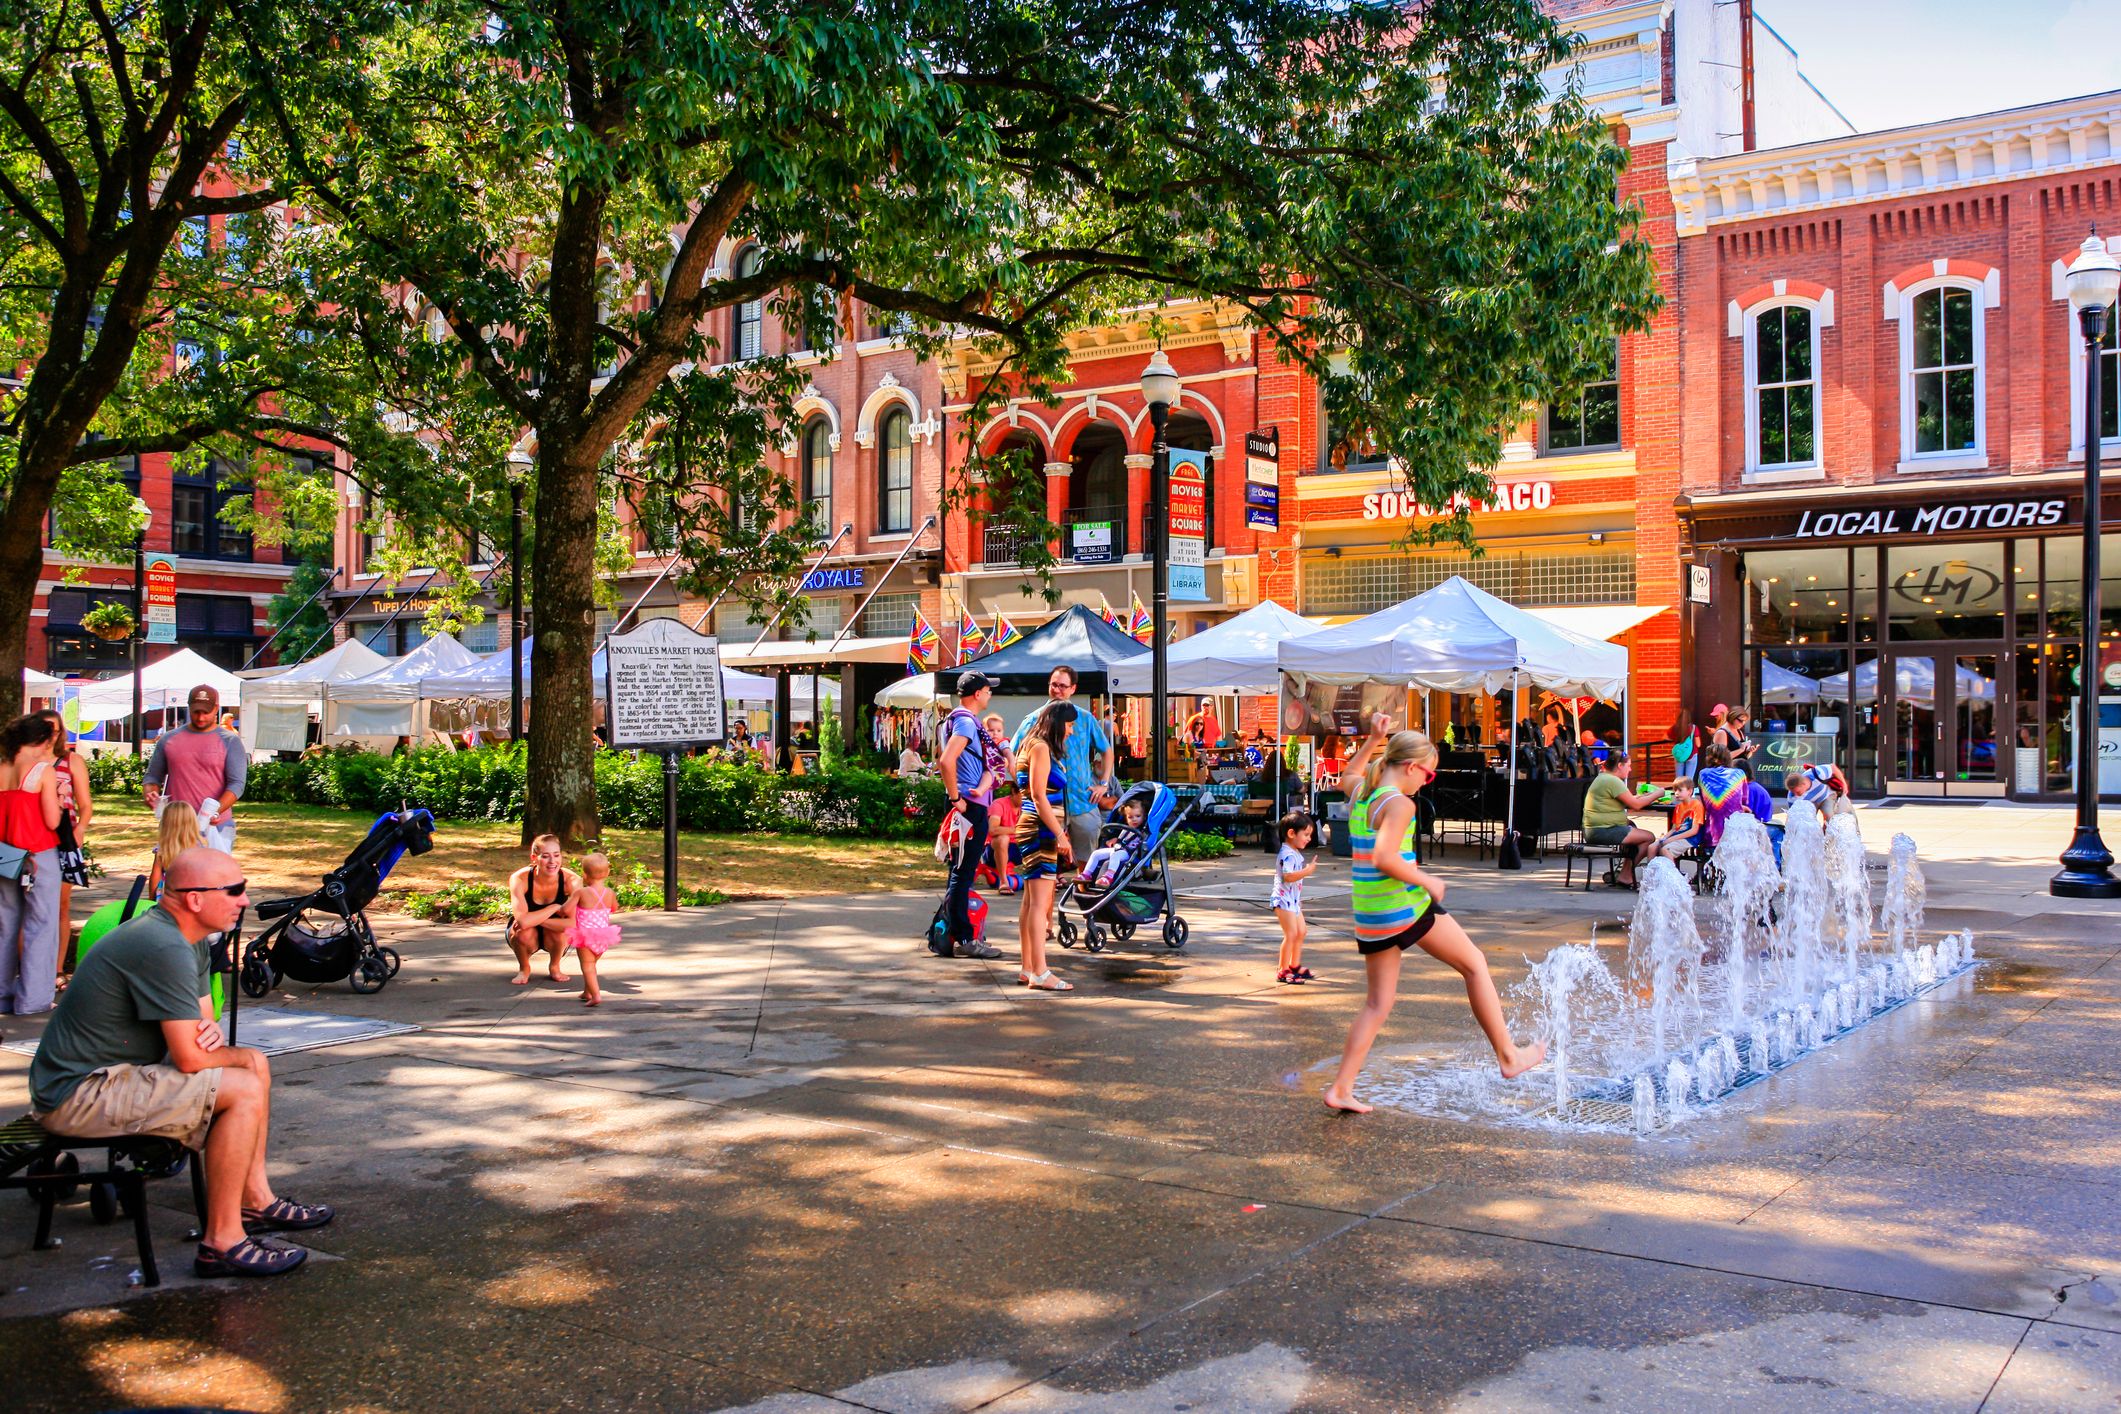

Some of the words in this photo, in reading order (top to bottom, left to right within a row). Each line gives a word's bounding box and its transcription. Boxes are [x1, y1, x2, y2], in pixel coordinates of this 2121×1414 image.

[1250, 440, 1268, 453] STUDIO
[1172, 484, 1202, 497] MOVIES
[1172, 502, 1202, 515] MARKET
[1363, 489, 1471, 520] SOCR
[1172, 518, 1202, 531] SQUARE
[1796, 511, 1901, 538] LOCAL
[1912, 501, 2065, 536] MOTORS
[150, 574, 174, 582] MOVIES
[803, 569, 864, 589] ROYALE
[1172, 580, 1202, 588] LIBRARY
[373, 601, 408, 613] TUPELO
[694, 647, 716, 655] HOUSE
